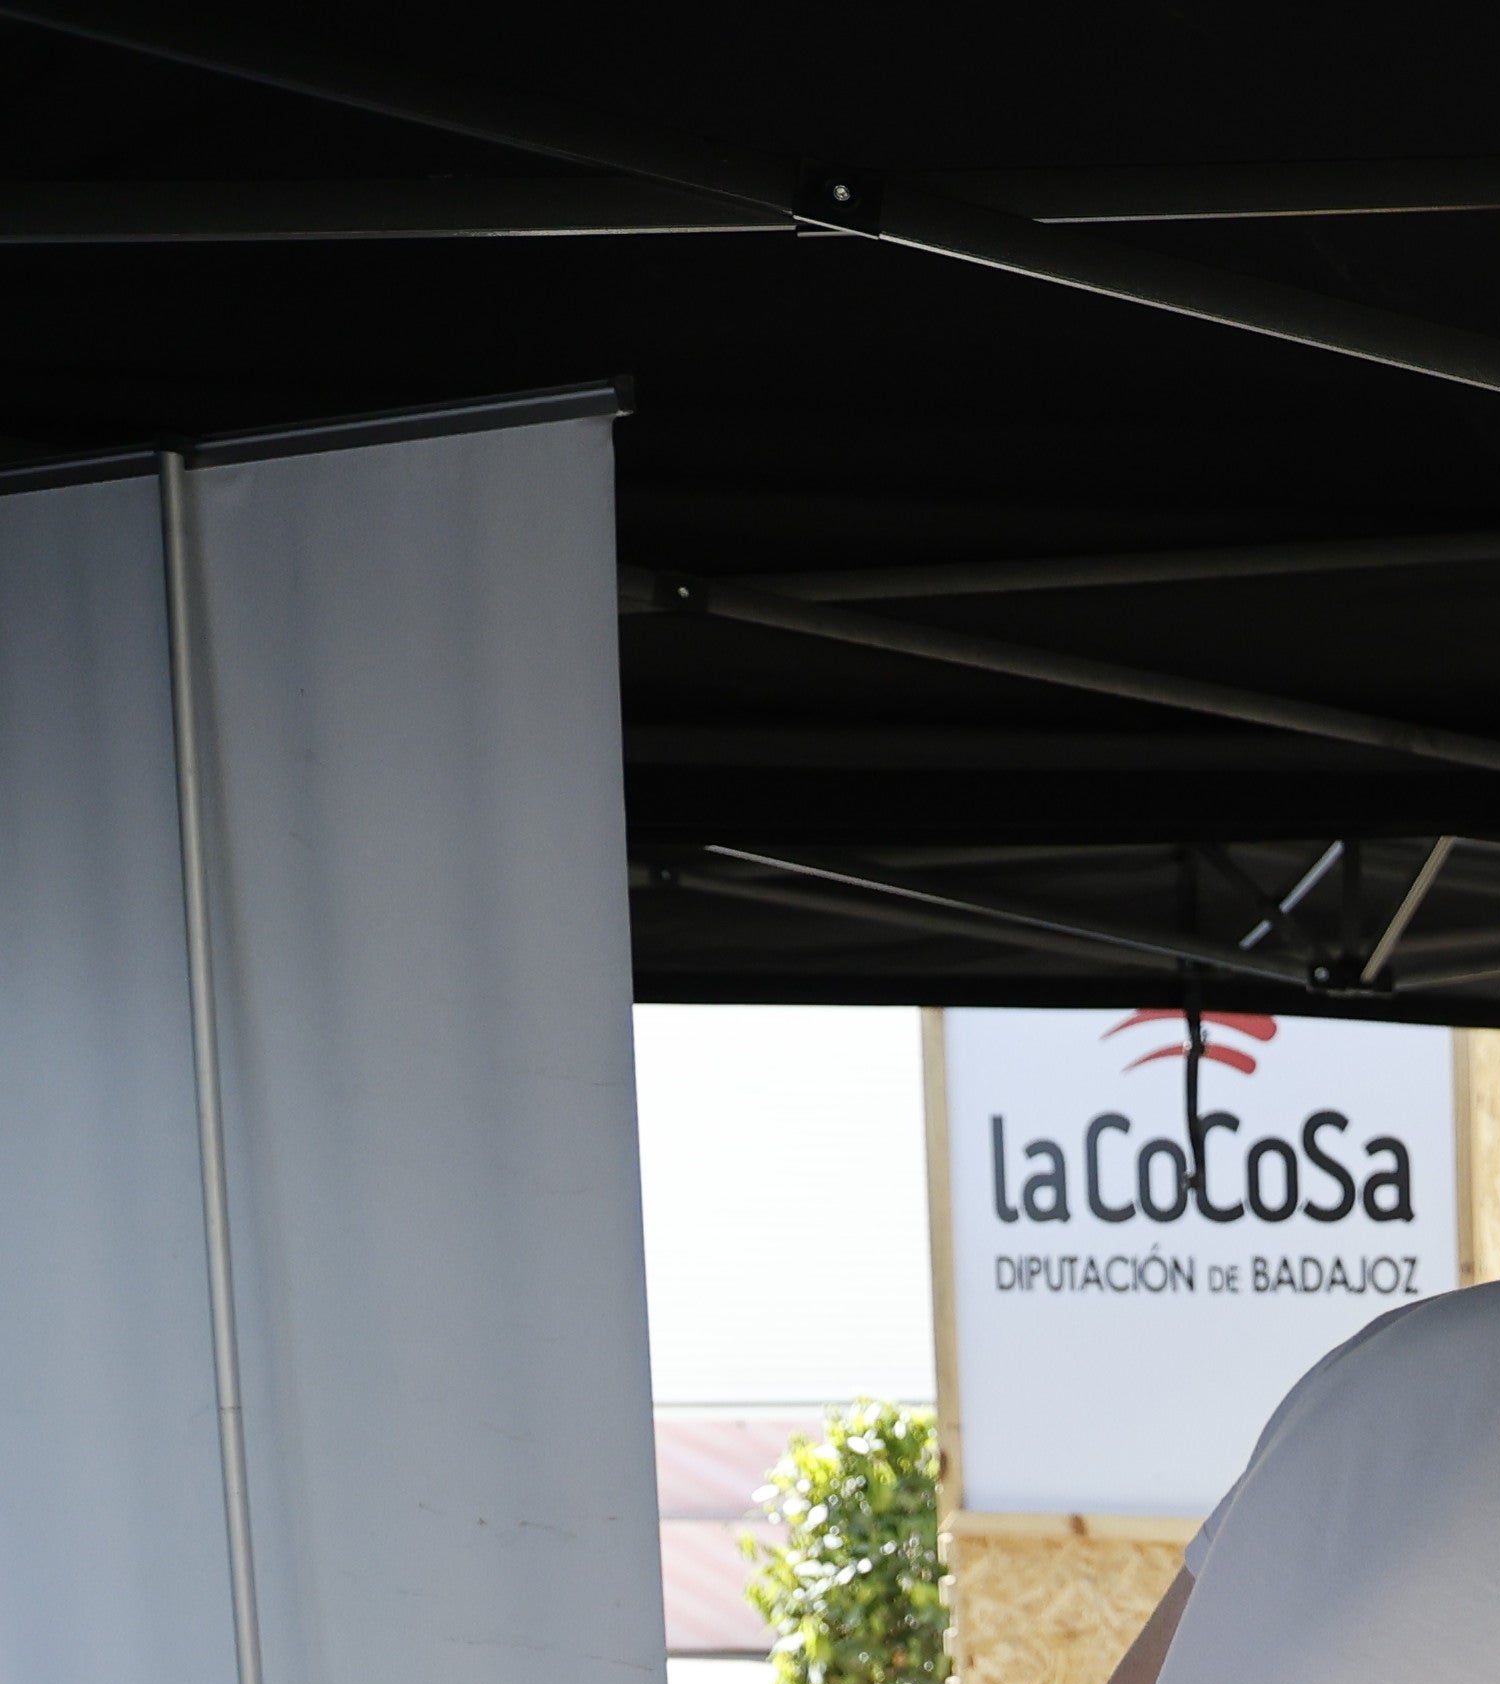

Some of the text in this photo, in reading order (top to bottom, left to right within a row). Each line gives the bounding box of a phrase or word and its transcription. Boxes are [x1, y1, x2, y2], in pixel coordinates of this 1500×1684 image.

[995, 1244, 1420, 1295] DIPUTACIÓN DE BADAJOZ
